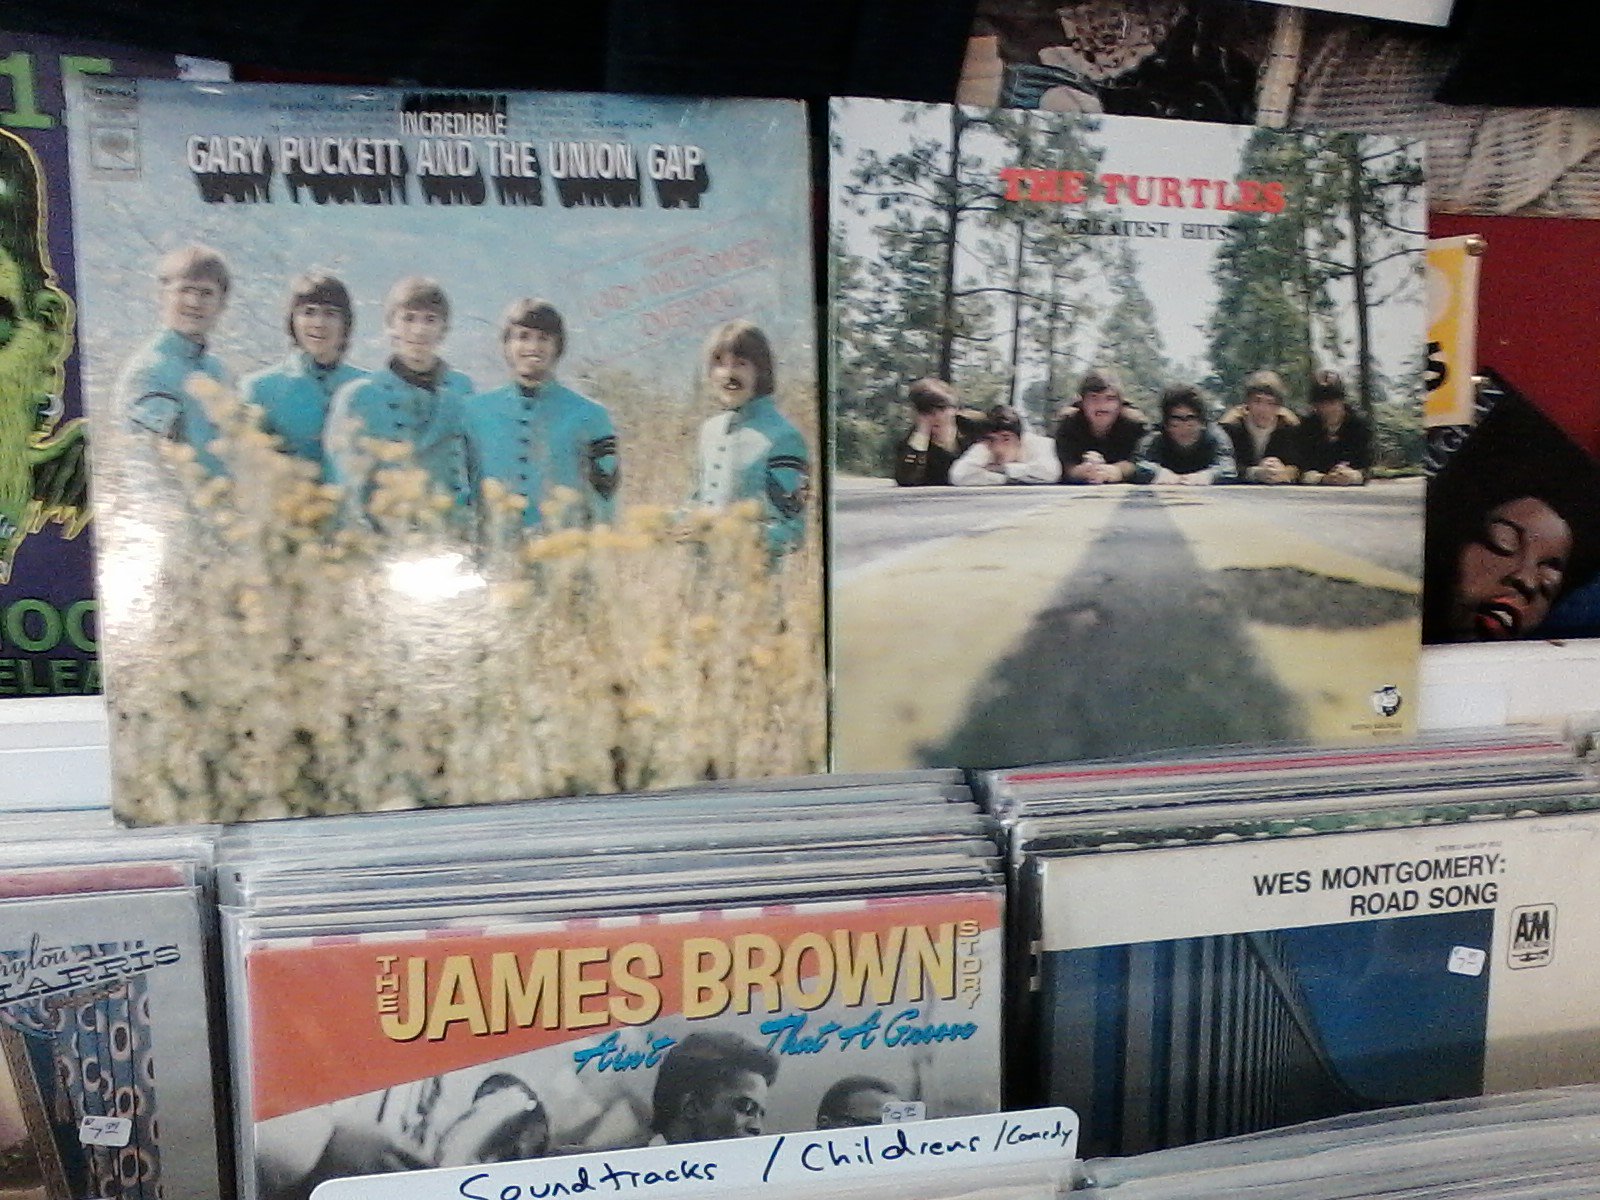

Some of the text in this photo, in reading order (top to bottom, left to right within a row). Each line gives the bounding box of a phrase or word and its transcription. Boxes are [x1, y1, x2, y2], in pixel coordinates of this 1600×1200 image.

[400, 110, 507, 137] INCREDIBLE
[186, 135, 704, 183] GARY PUCKETT AND THE UNION GAP
[999, 167, 1287, 215] THE TURTLES
[1061, 219, 1236, 240] GREATEST HITS
[1253, 853, 1506, 896] WES MONTGOMERY:
[1350, 882, 1499, 917] ROAD SONG
[0, 932, 69, 985] ylou
[377, 921, 957, 1043] JAMES BROWN
[959, 919, 982, 1010] STORY
[375, 955, 399, 1014] THE
[573, 1030, 677, 1075] Ain't
[760, 1012, 841, 1056] That
[839, 1009, 882, 1052] A
[459, 1160, 718, 1200] Soundtracks
